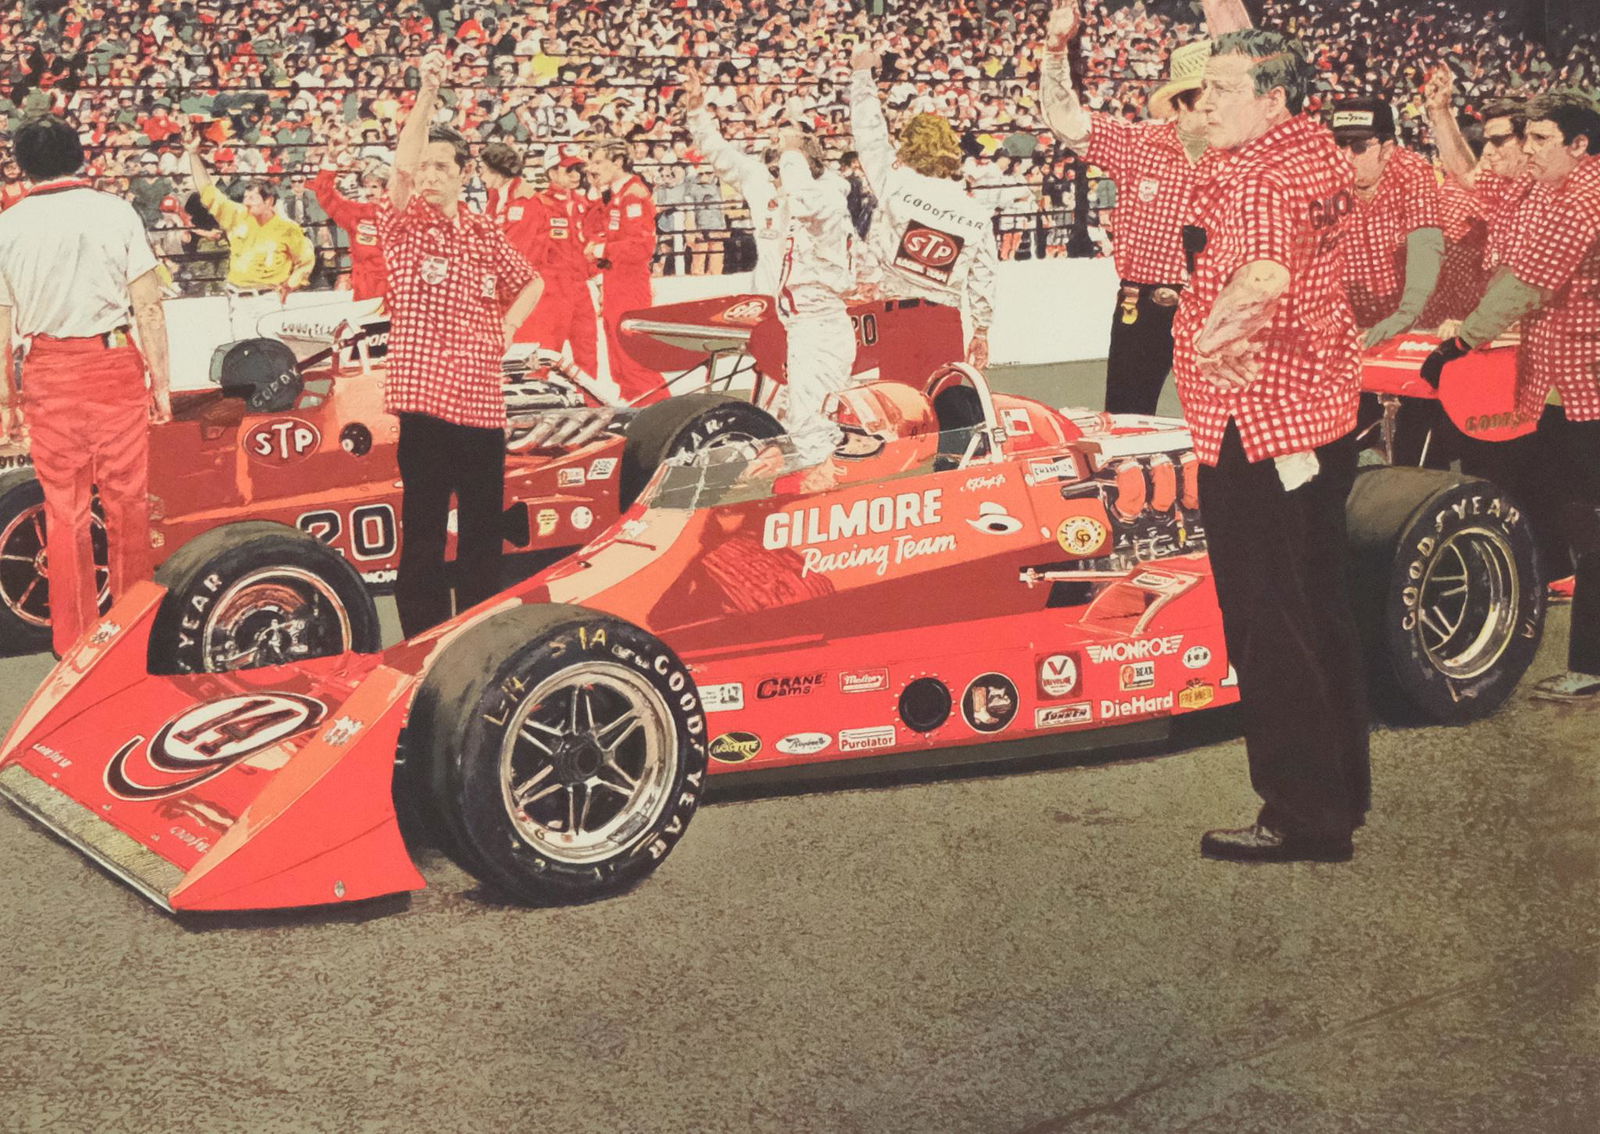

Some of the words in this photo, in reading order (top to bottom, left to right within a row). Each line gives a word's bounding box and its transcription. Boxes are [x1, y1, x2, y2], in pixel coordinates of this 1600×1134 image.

[908, 234, 952, 259] STP
[255, 422, 312, 459] STP
[763, 488, 943, 550] GILMORE
[801, 546, 889, 578] Racing
[893, 533, 957, 564] Team
[178, 574, 222, 648] YEAR
[1096, 637, 1176, 663] MONROE
[757, 674, 824, 699] CRANE
[1101, 690, 1174, 718] DieHard
[841, 737, 893, 750] Purolator
